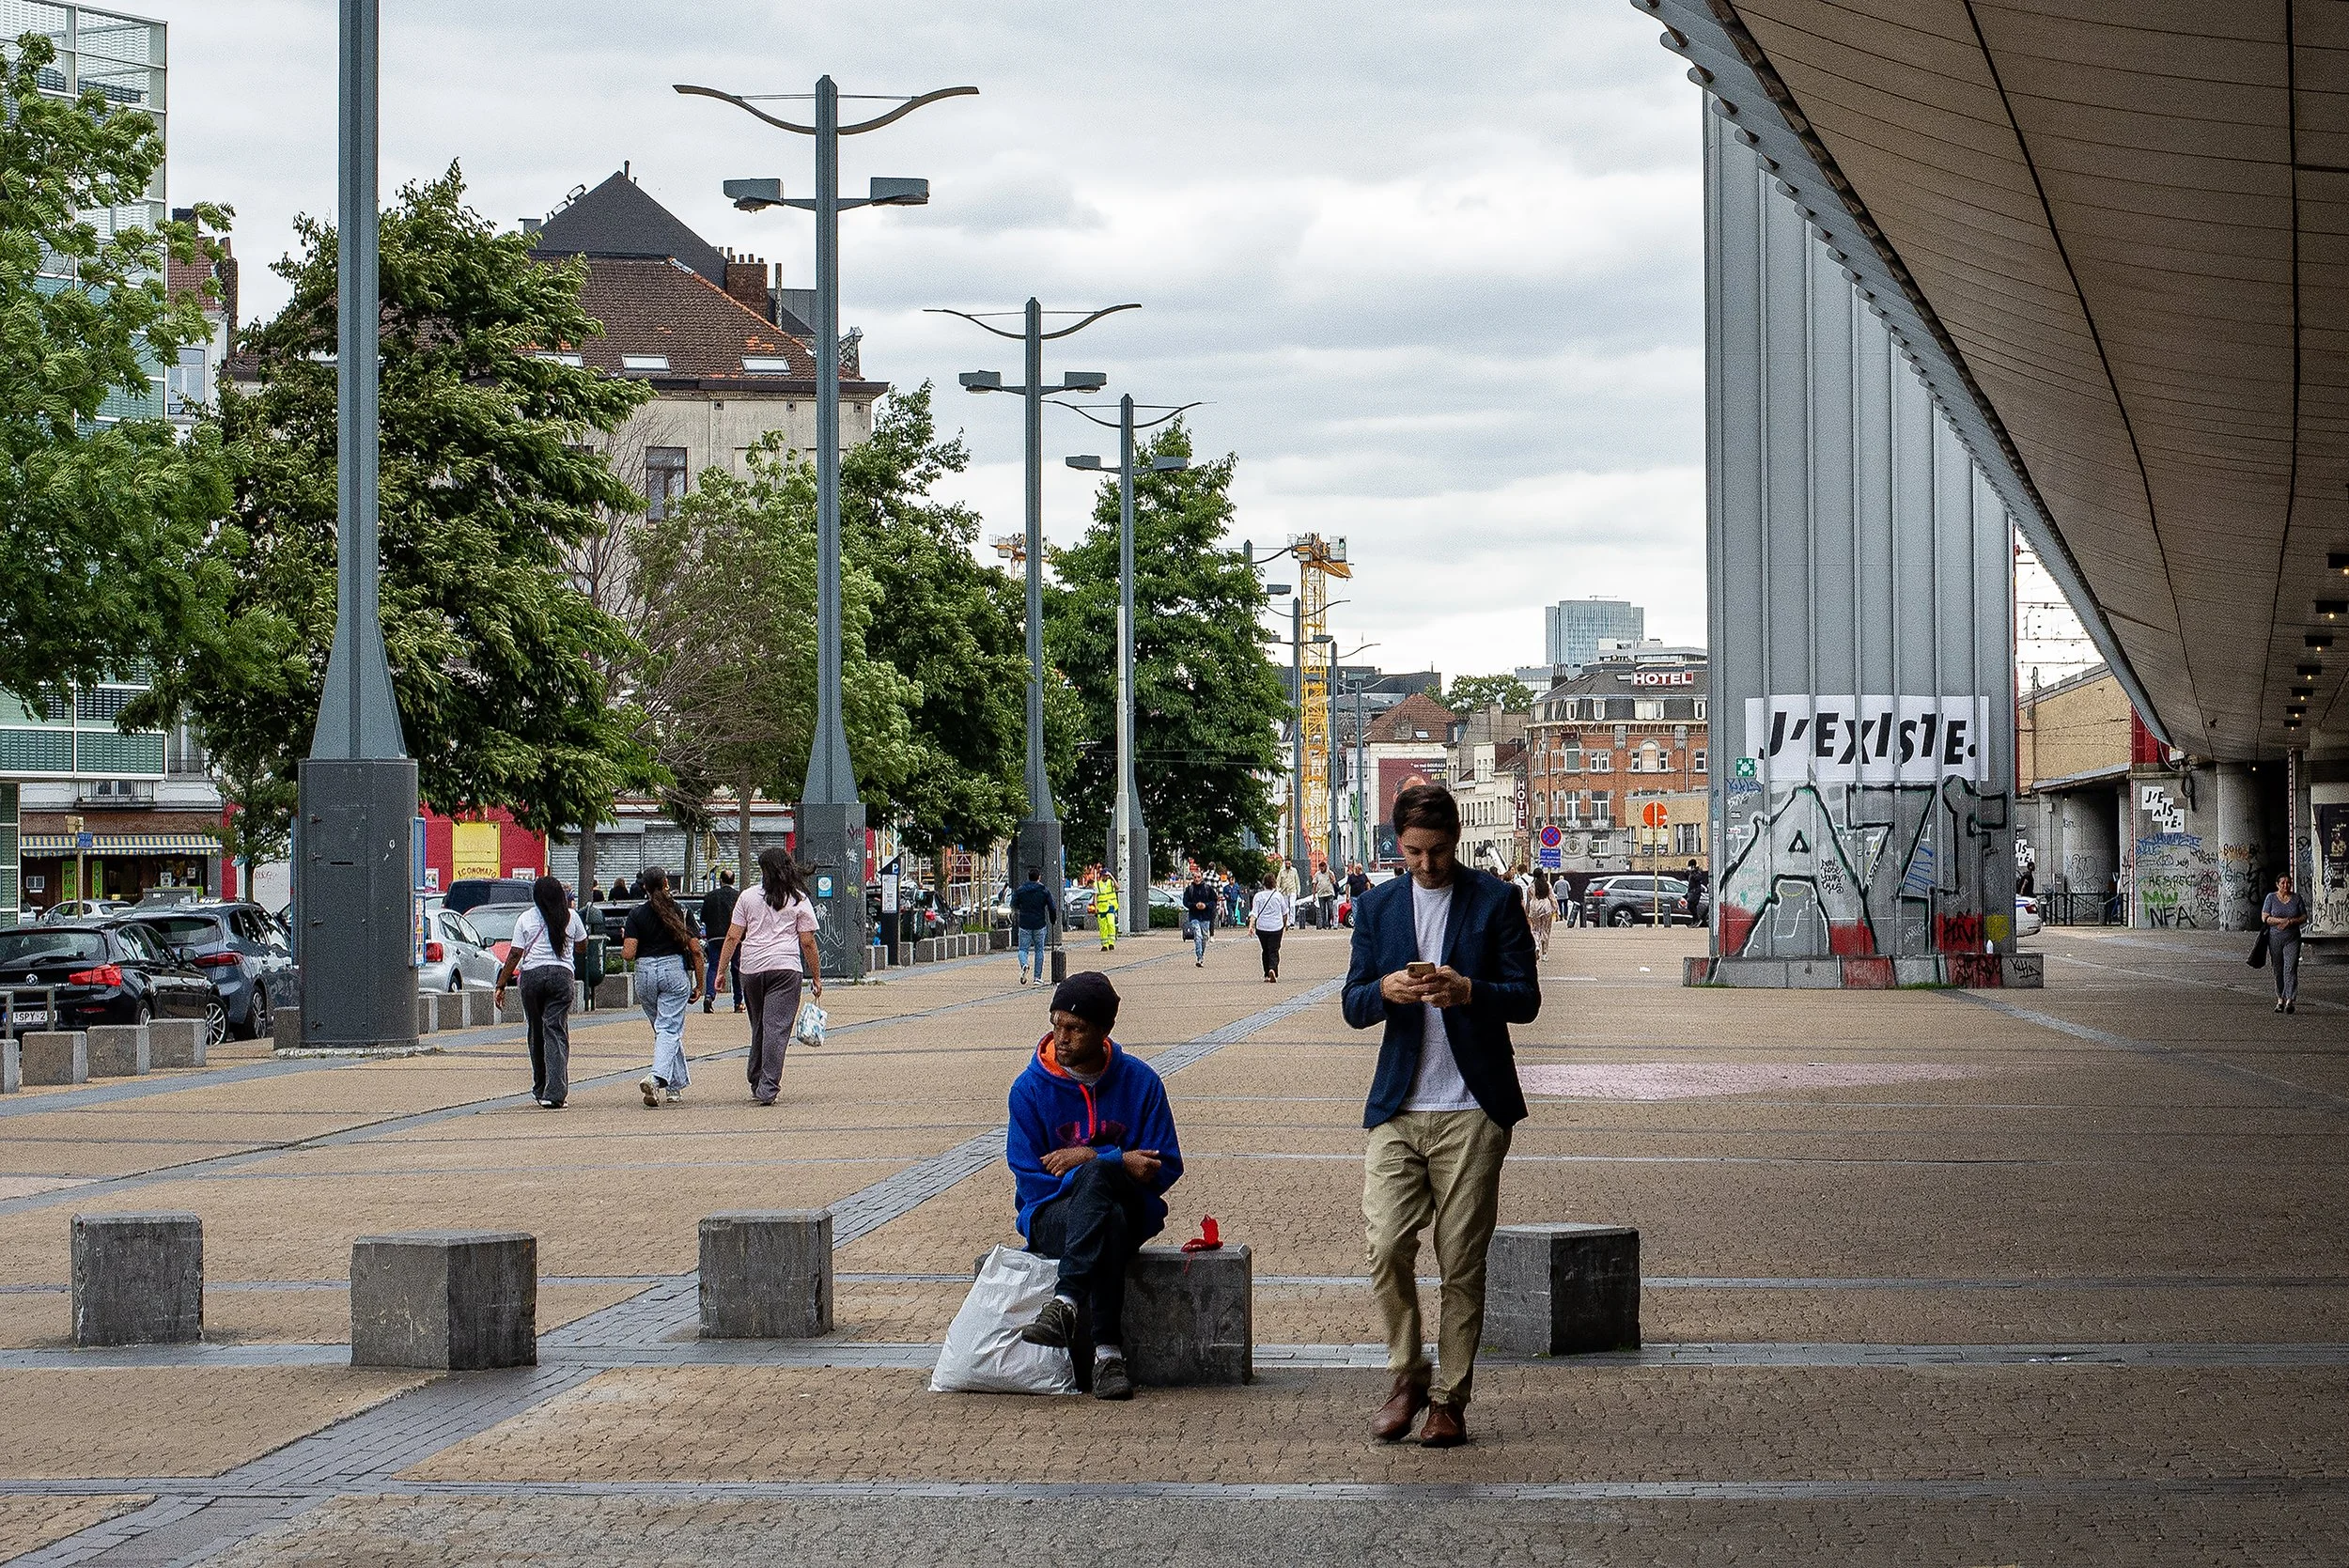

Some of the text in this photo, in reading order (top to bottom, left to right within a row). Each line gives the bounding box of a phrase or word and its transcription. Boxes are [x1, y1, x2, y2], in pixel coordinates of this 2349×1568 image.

[1633, 673, 1692, 685] HOTEL
[1758, 711, 1977, 768] J'EXISTE.
[2145, 791, 2164, 803] J'E
[1517, 780, 1526, 829] HOTEL
[457, 866, 497, 879] ECONOMATO
